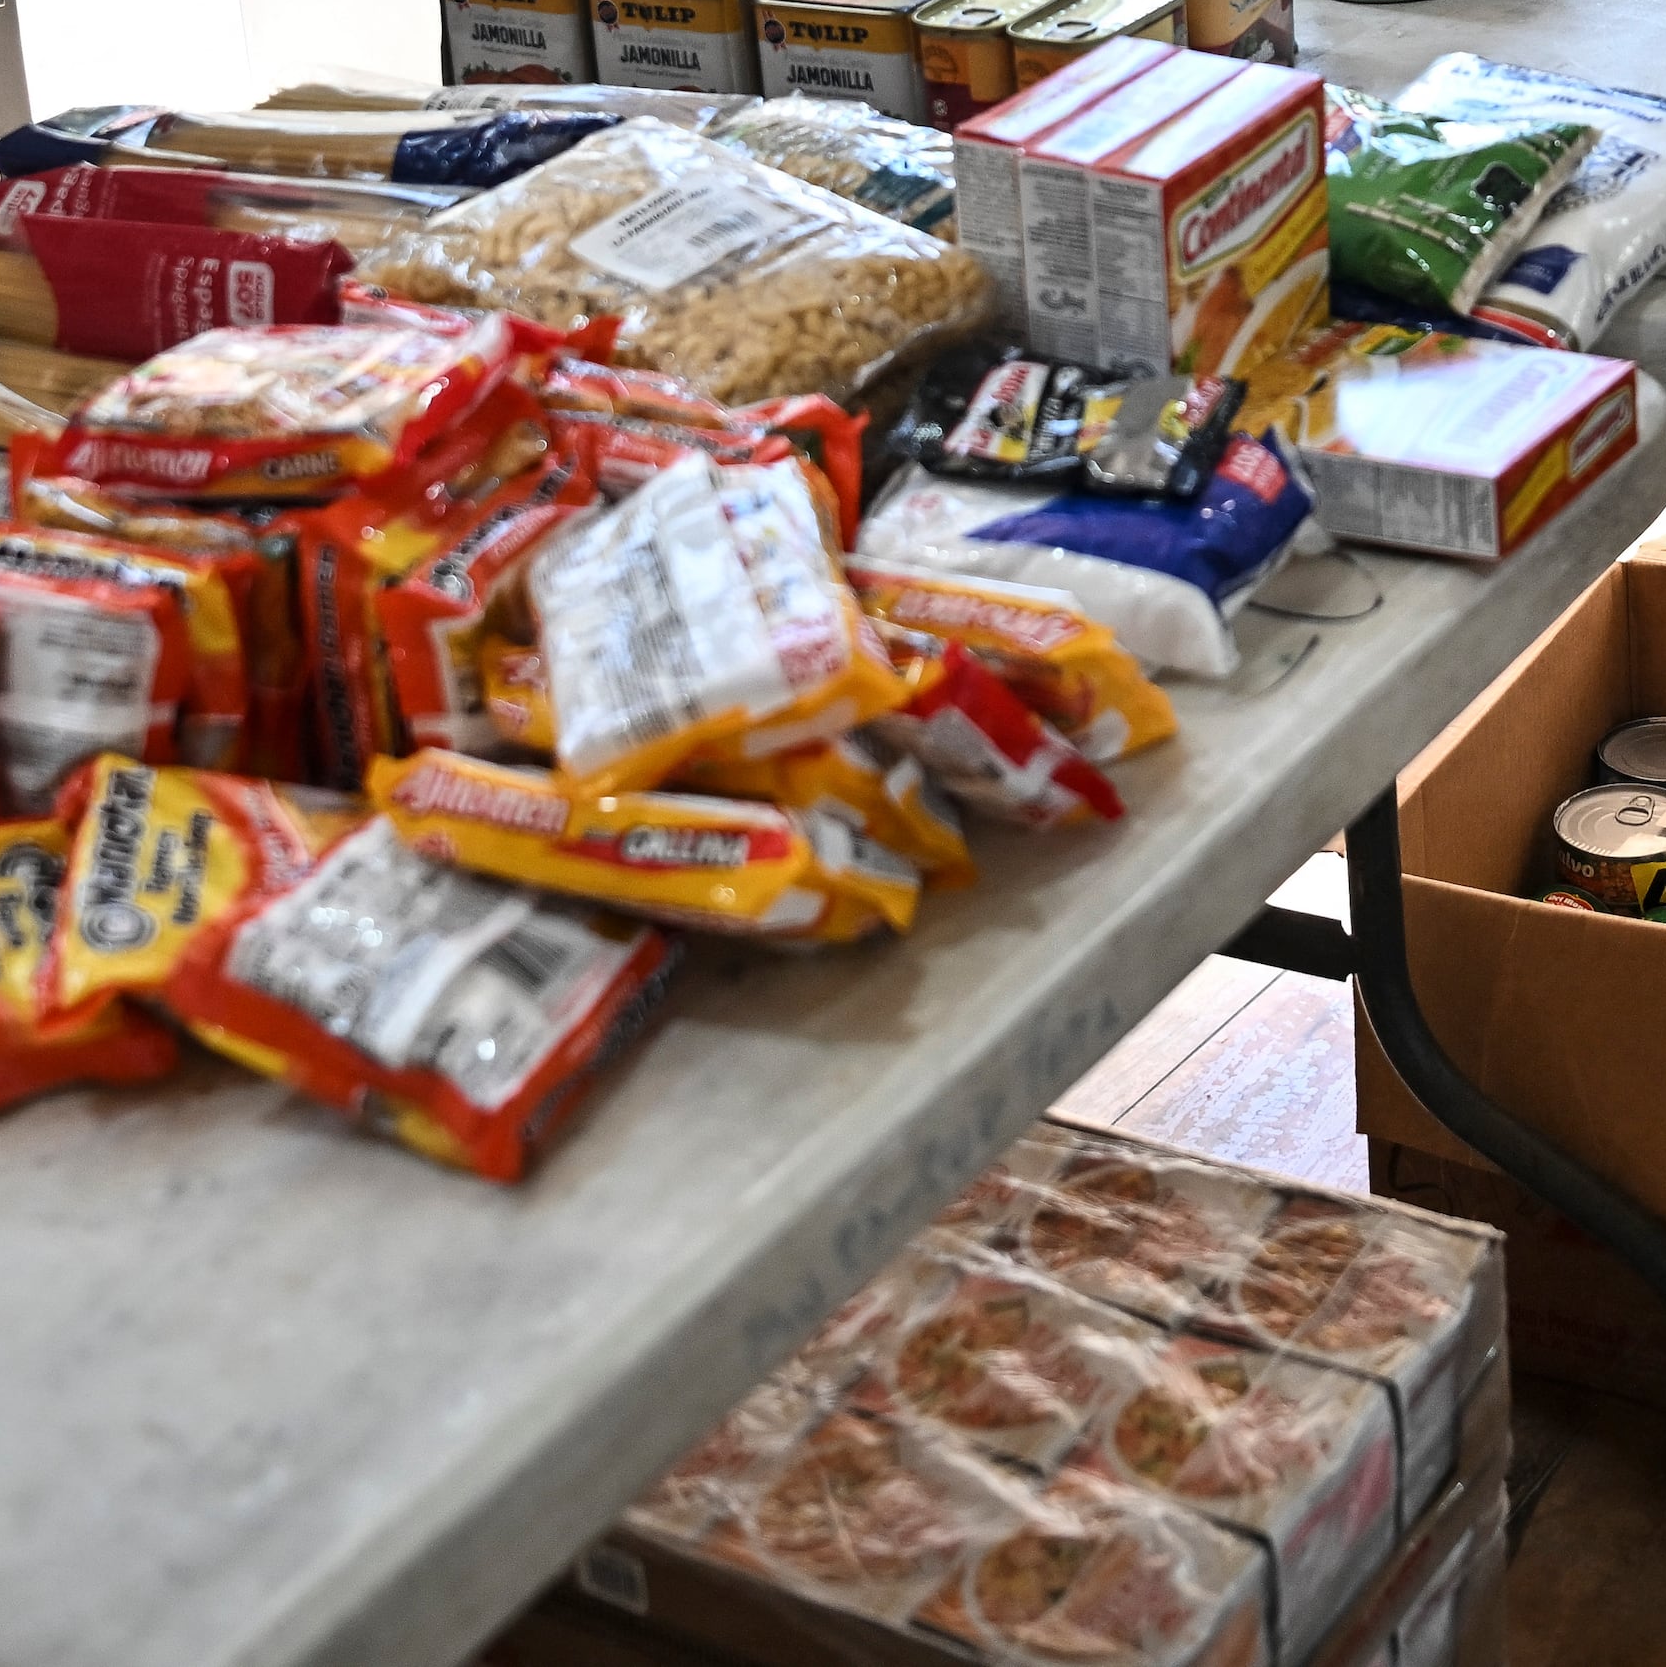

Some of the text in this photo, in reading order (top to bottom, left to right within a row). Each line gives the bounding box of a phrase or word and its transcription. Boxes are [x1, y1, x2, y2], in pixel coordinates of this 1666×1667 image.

[621, 1, 696, 24] TULIP
[471, 22, 548, 50] JAMONILLA
[789, 20, 869, 44] TULIP
[621, 44, 701, 72] JAMONILLA
[787, 64, 874, 92] JAMONILLA
[1181, 120, 1310, 264] Continental
[237, 269, 254, 320] 507
[1558, 849, 1595, 879] alvo
